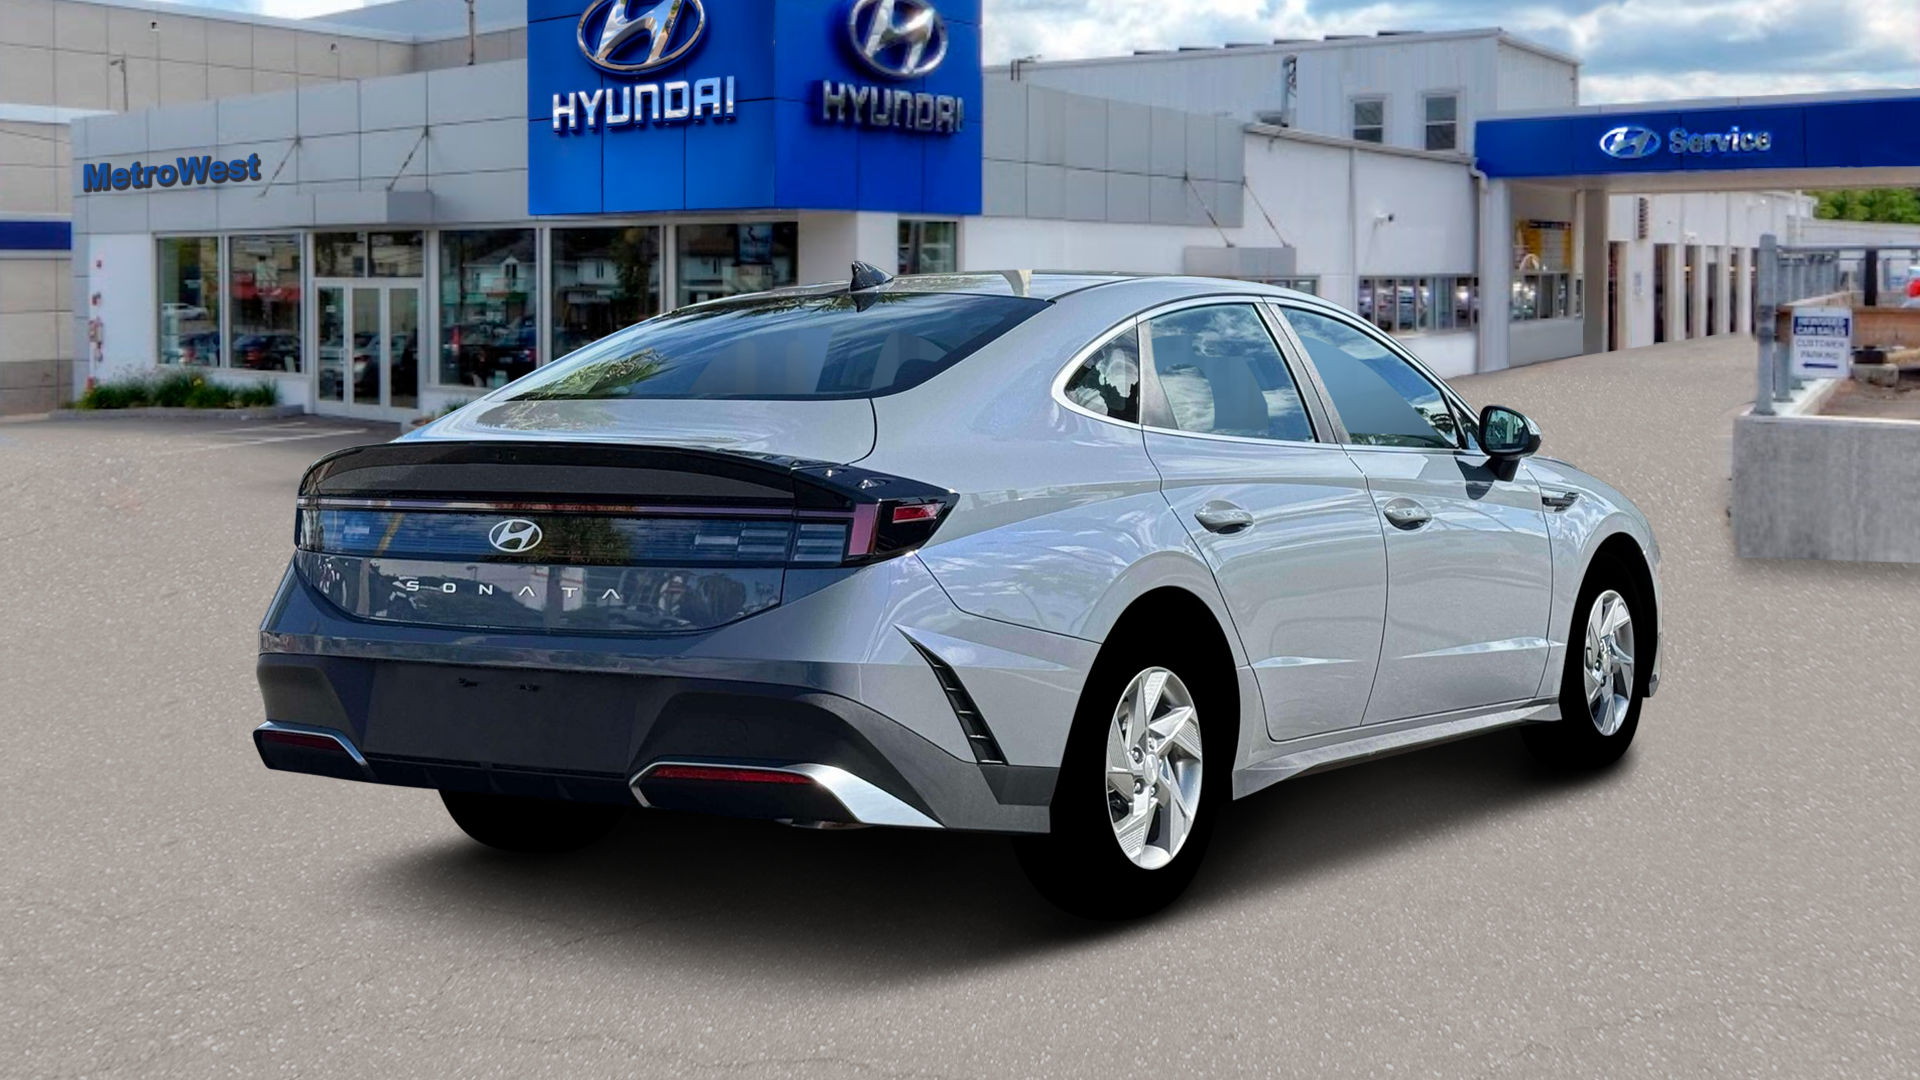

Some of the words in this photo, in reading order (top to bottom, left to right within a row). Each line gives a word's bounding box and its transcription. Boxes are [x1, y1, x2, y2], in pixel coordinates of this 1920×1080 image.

[552, 75, 736, 134] HYUNDAI
[822, 80, 964, 133] HYUNDAI
[1669, 125, 1772, 153] Service
[83, 152, 262, 192] MetroWest
[1796, 326, 1816, 335] CAR
[1817, 326, 1845, 337] SALES
[1796, 339, 1845, 348] CUSTOMER
[1800, 351, 1840, 359] PARKING
[405, 580, 621, 600] SONATA
